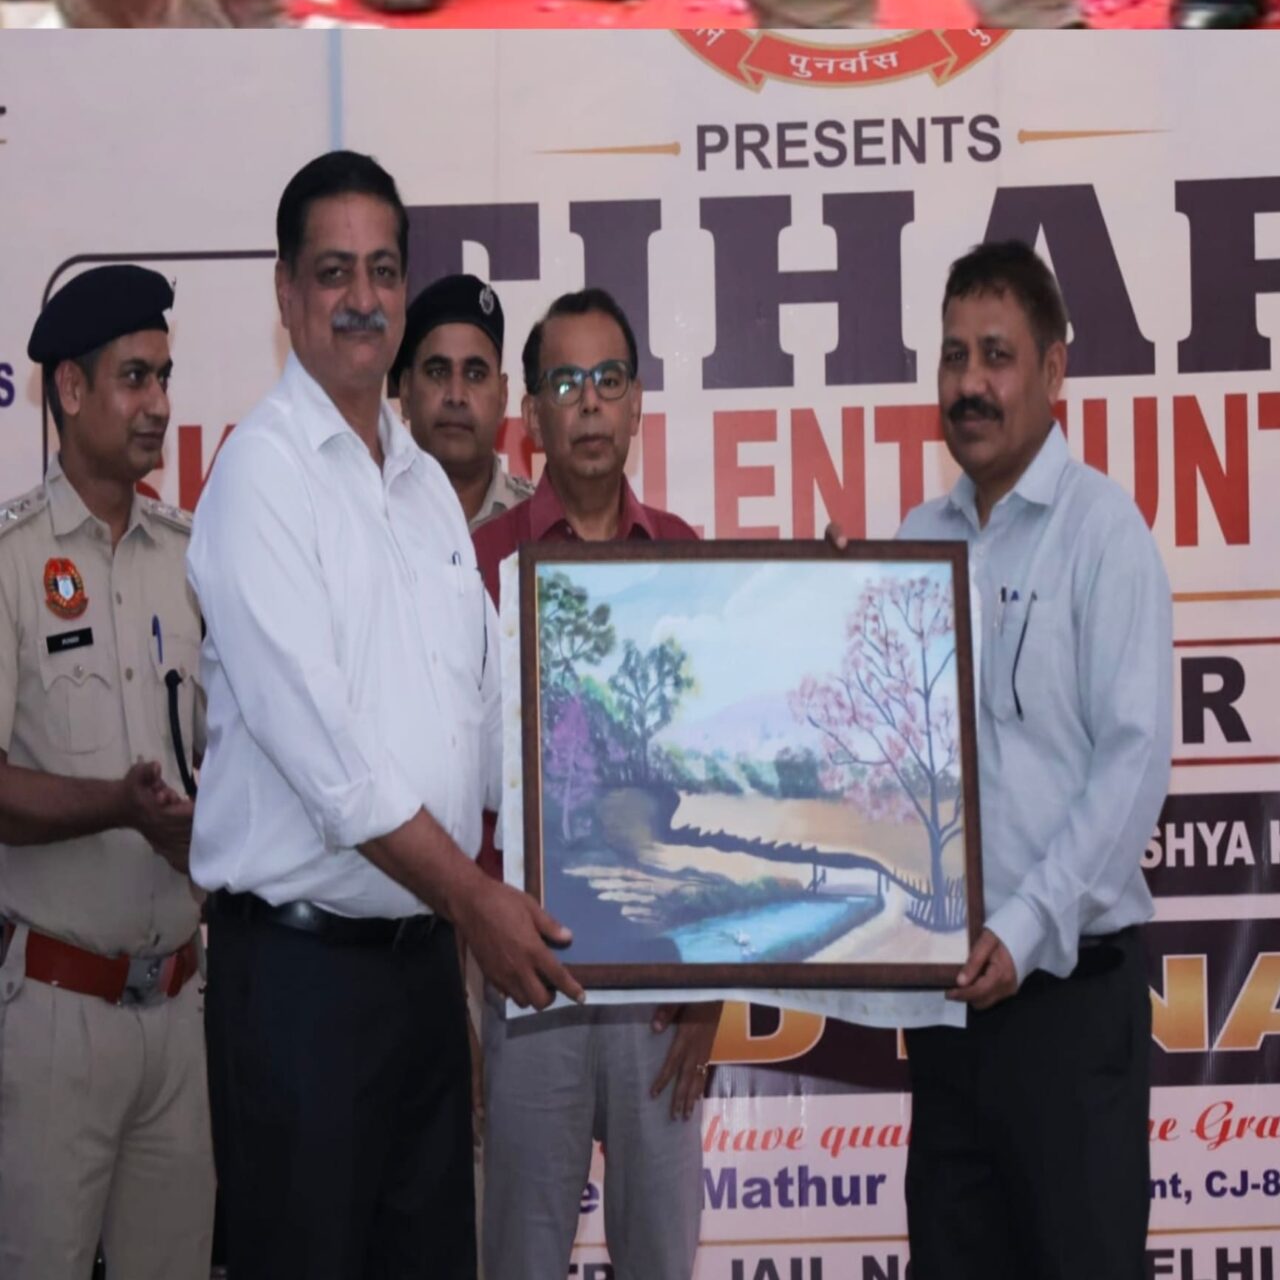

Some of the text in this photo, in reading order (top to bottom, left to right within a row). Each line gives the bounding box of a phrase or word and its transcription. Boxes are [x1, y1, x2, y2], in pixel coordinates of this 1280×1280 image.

[788, 50, 899, 78] पुनर्वास
[696, 114, 1002, 171] PRESENTS
[495, 404, 943, 540] LENT
[700, 1165, 887, 1211] Mathur
[1145, 1246, 1274, 1280] ELHI
